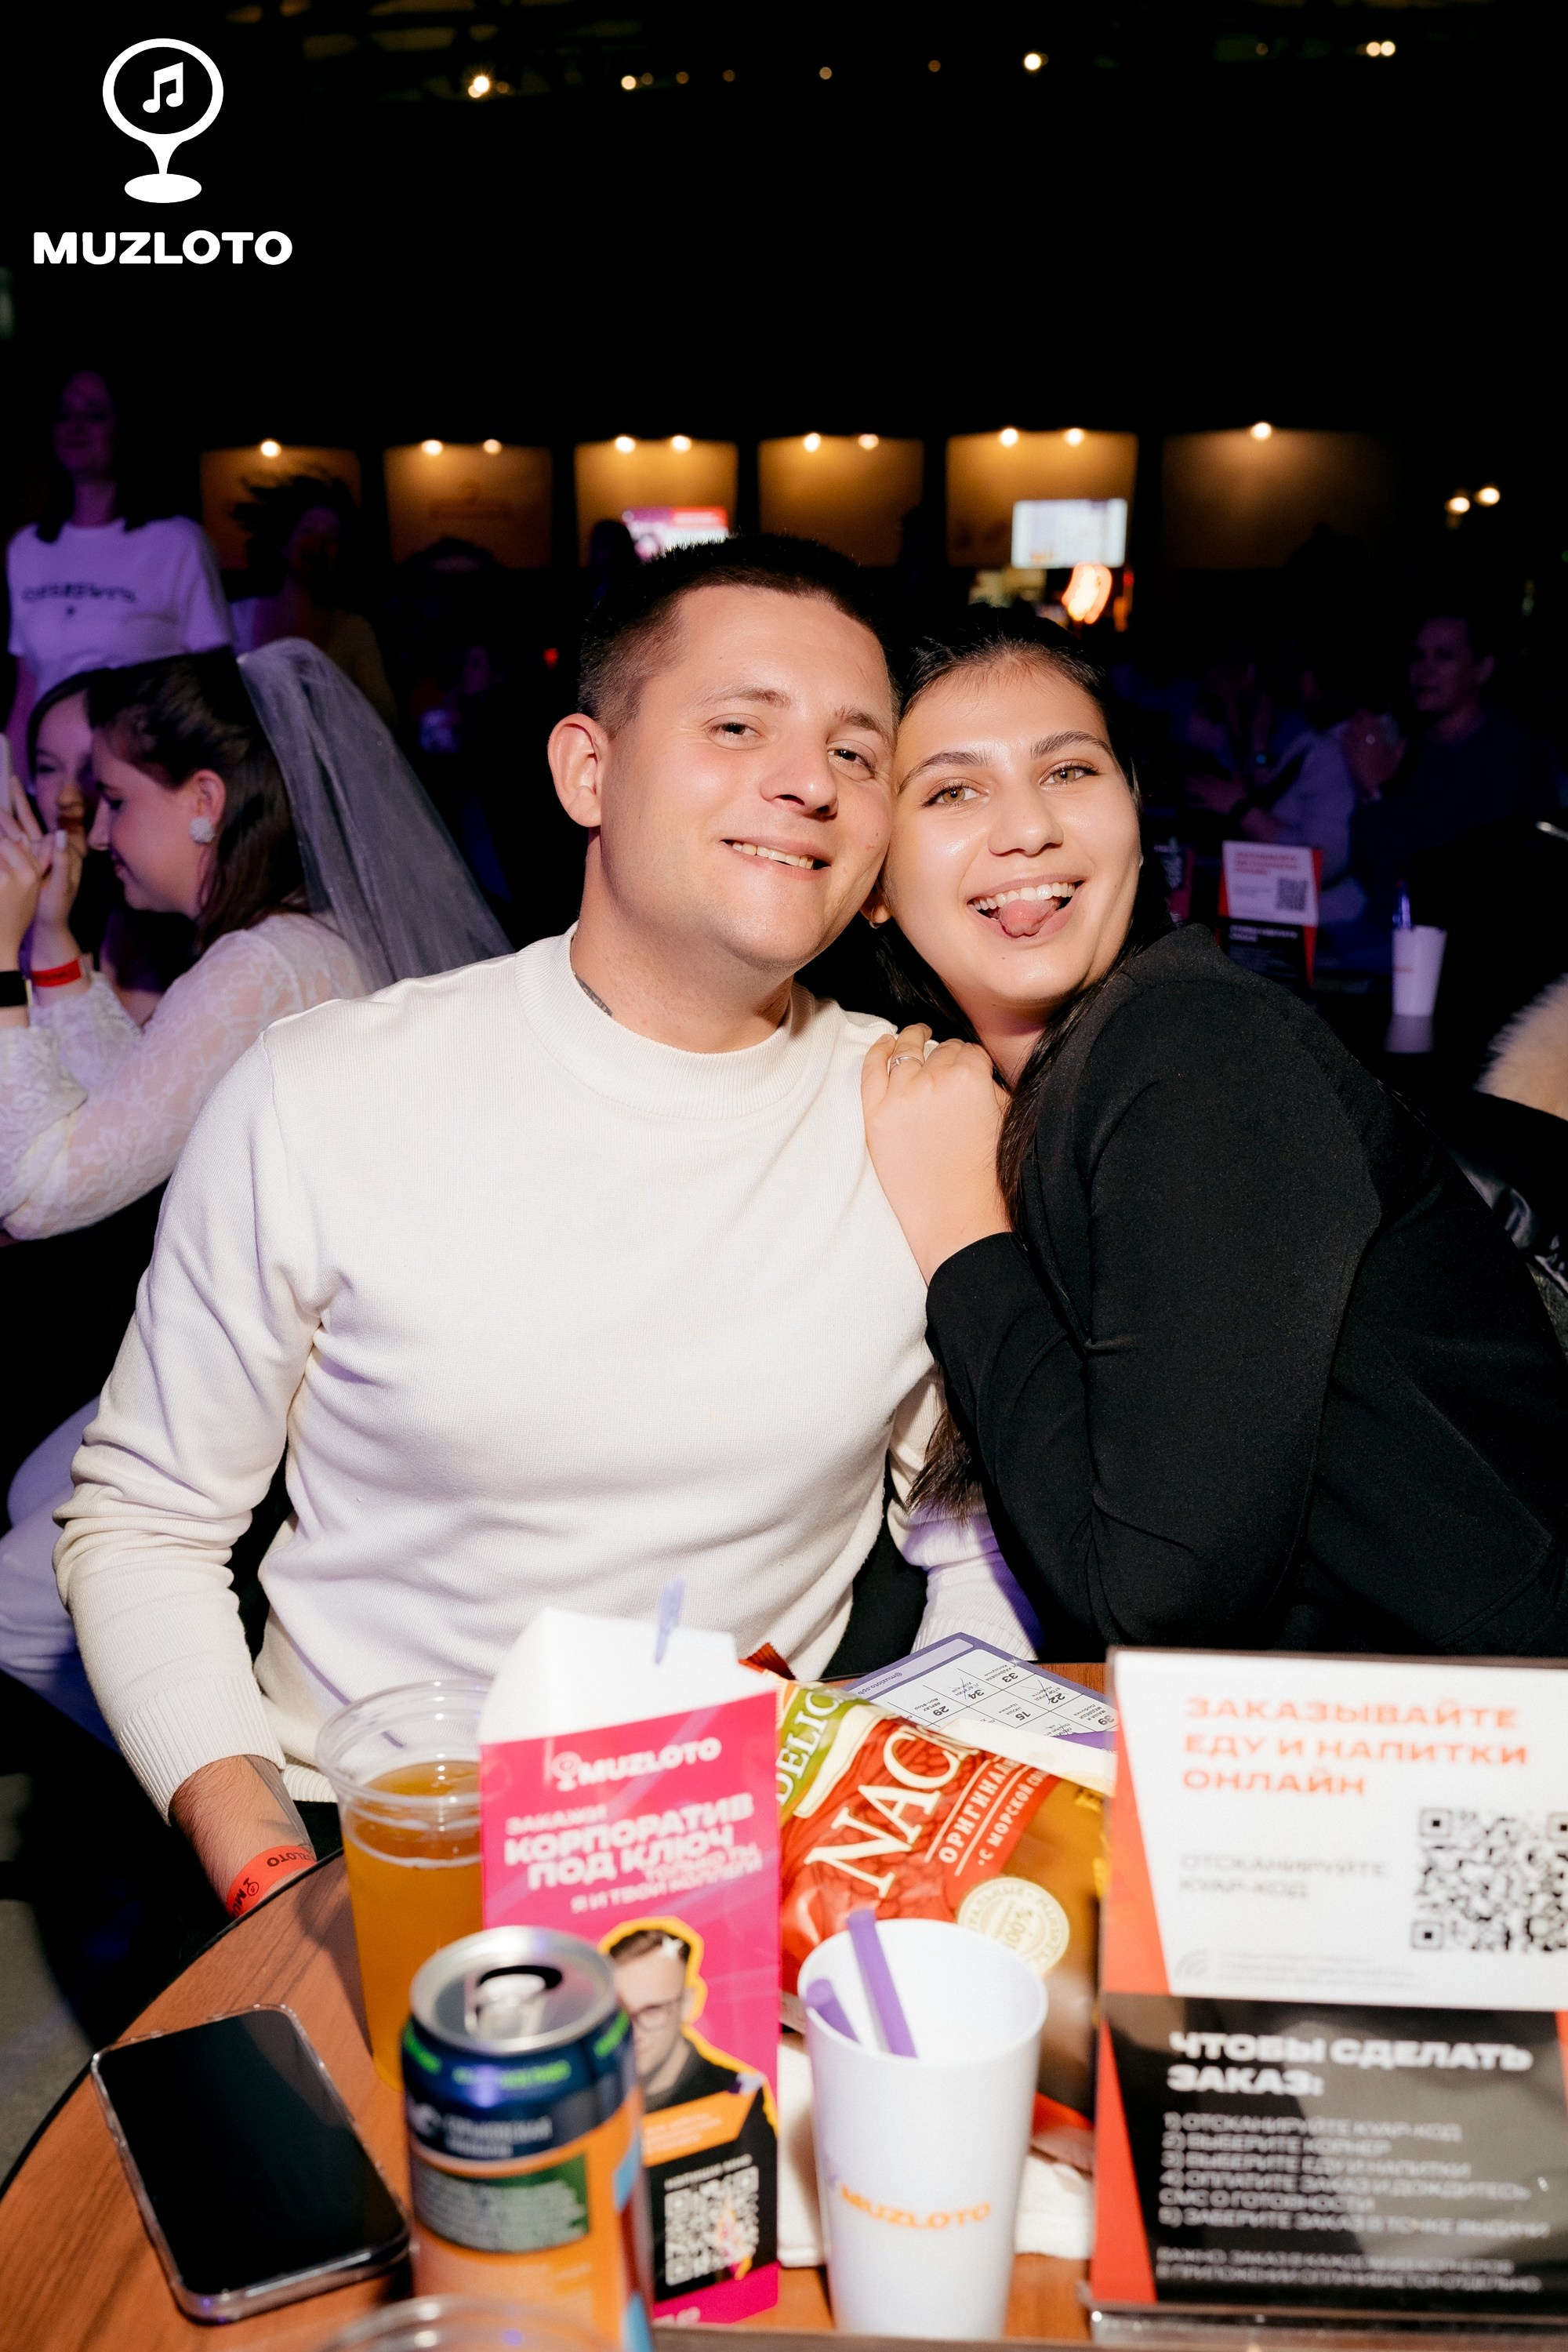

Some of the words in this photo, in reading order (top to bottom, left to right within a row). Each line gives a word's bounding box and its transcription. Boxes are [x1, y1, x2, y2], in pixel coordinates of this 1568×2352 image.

[858, 1672, 903, 1695] @muzloto.spb
[1001, 1672, 1018, 1682] 33
[967, 1689, 985, 1700] 34
[1049, 1693, 1065, 1704] 22
[933, 1705, 949, 1716] 29
[1015, 1711, 1031, 1721] 15
[1098, 1715, 1115, 1726] 39
[1185, 1696, 1519, 1731] ЗАКАЗЫВАЙТЕ
[577, 1737, 722, 1786] MUZLOTO
[1184, 1733, 1269, 1759] ЕДУ
[1278, 1737, 1304, 1759] И
[1317, 1739, 1529, 1767] НАПИТКИ
[1182, 1766, 1366, 1795] ОНЛАЙН
[504, 1792, 754, 1866] КОРПОРАТИВ
[528, 1851, 617, 1890] ПОД
[621, 1825, 735, 1873] КЛЮЧ
[1168, 2031, 1326, 2064] ЧТОБЫ
[1330, 2038, 1534, 2072] СДЕЛАТЬ
[1167, 2064, 1325, 2096] ЗАКАЗ:
[840, 2183, 991, 2230] MUZLOTO
